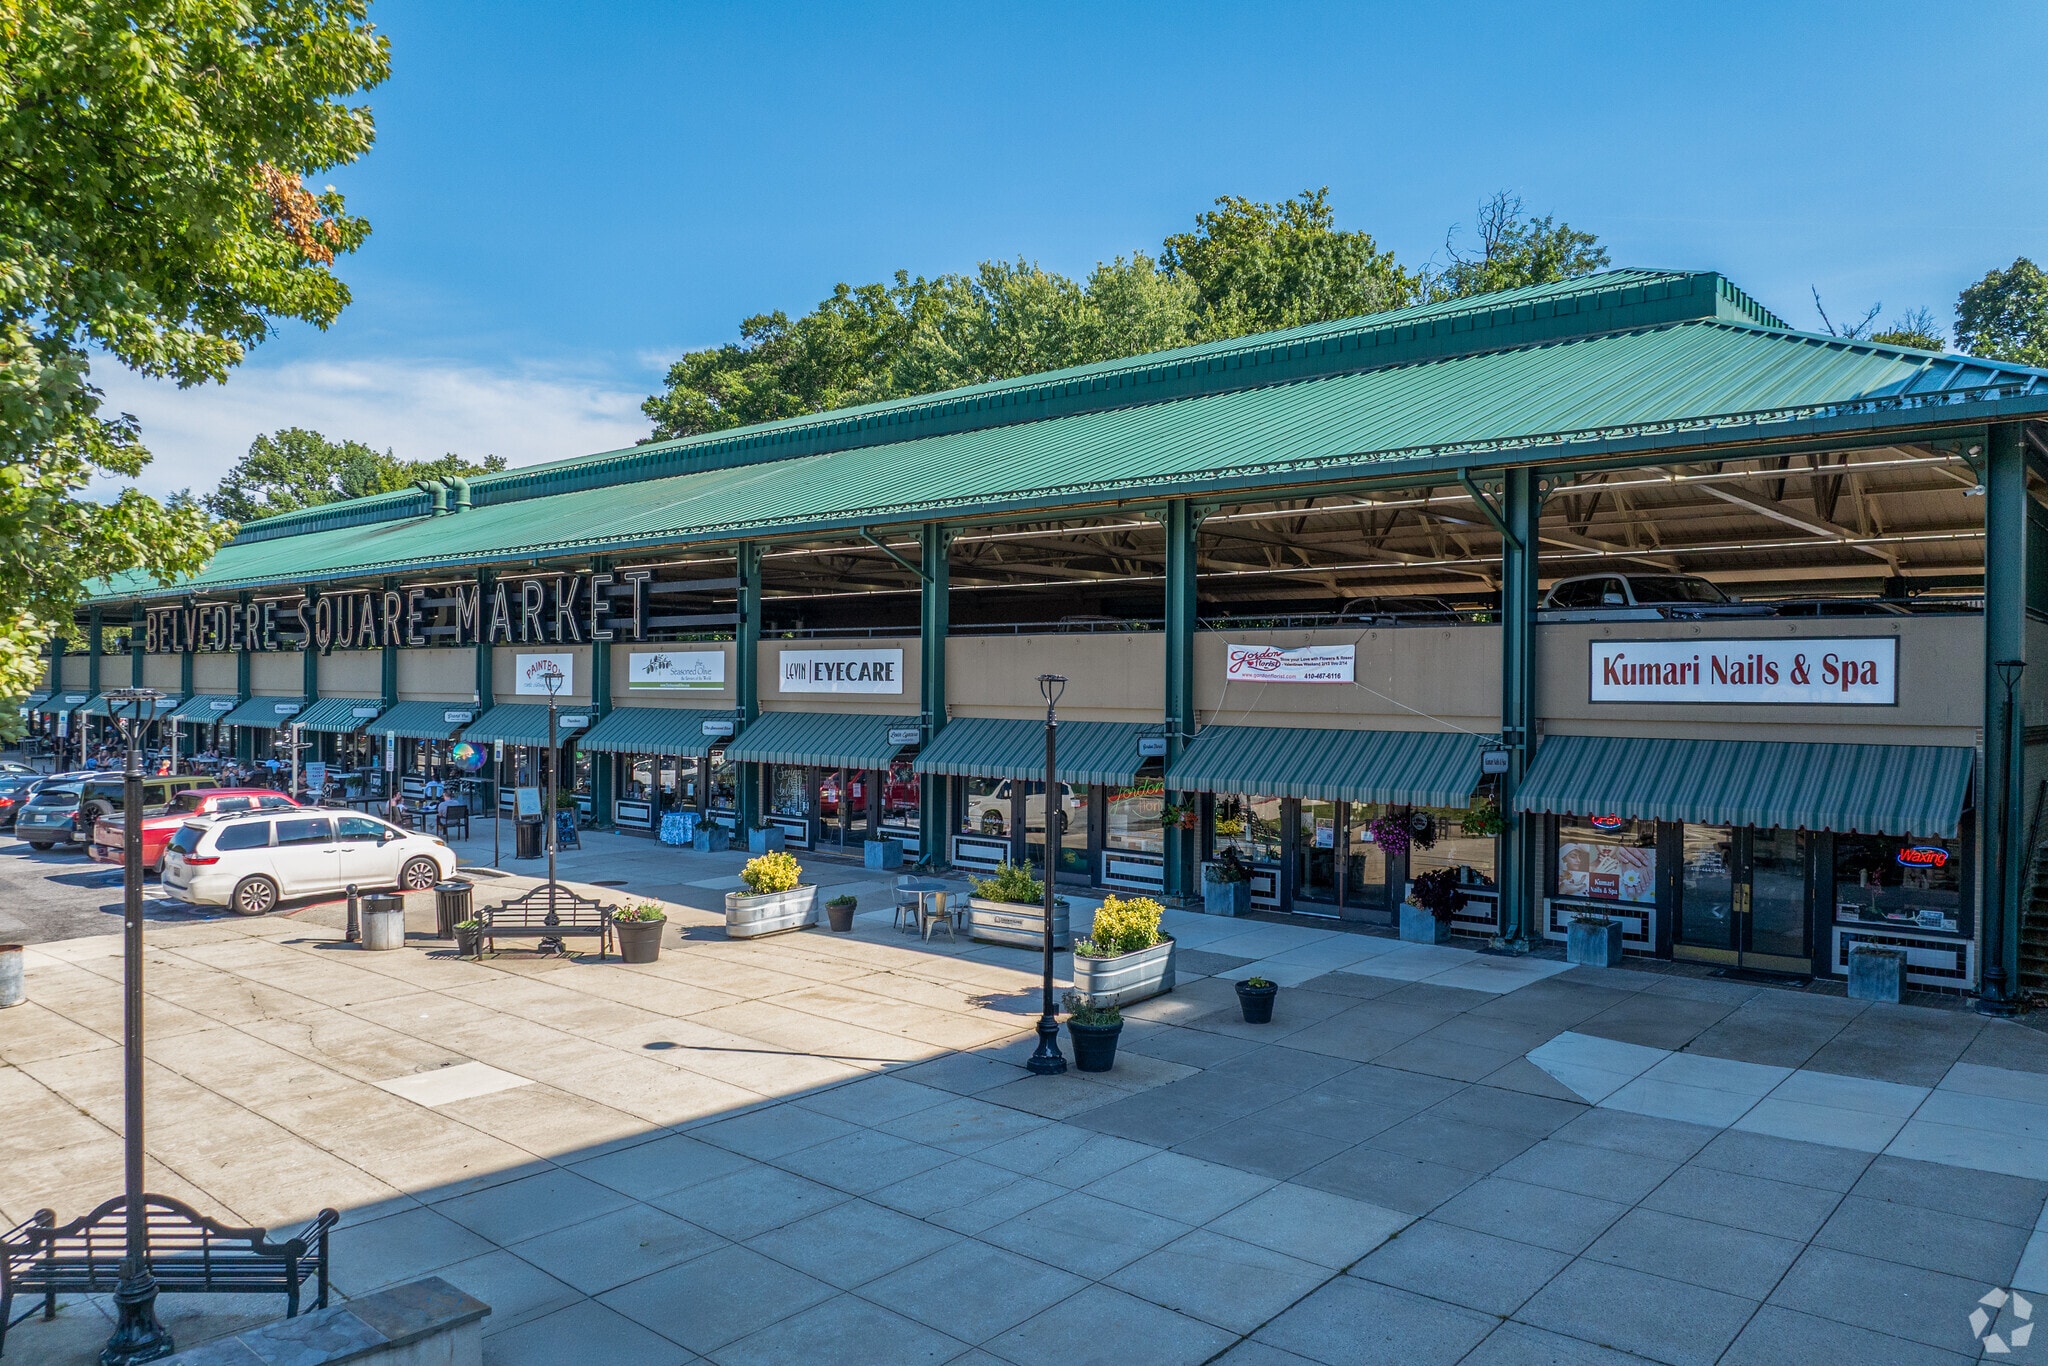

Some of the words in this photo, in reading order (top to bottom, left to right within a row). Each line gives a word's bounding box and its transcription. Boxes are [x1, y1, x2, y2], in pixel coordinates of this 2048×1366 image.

[146, 602, 278, 653] BELVEDERE
[297, 589, 426, 655] SQUARE
[456, 571, 651, 643] MARKET
[526, 659, 562, 679] PAINTBO
[785, 662, 806, 680] LEVIN
[814, 661, 895, 681] EYECARE
[1603, 652, 1700, 686] Kumari
[1711, 653, 1780, 685] Nails
[1789, 653, 1811, 685] &
[1821, 653, 1879, 692] Spa
[1900, 848, 1946, 867] Waxing
[1590, 886, 1602, 894] Nails
[1608, 888, 1618, 896] Spa
[1594, 878, 1615, 887] Kumari
